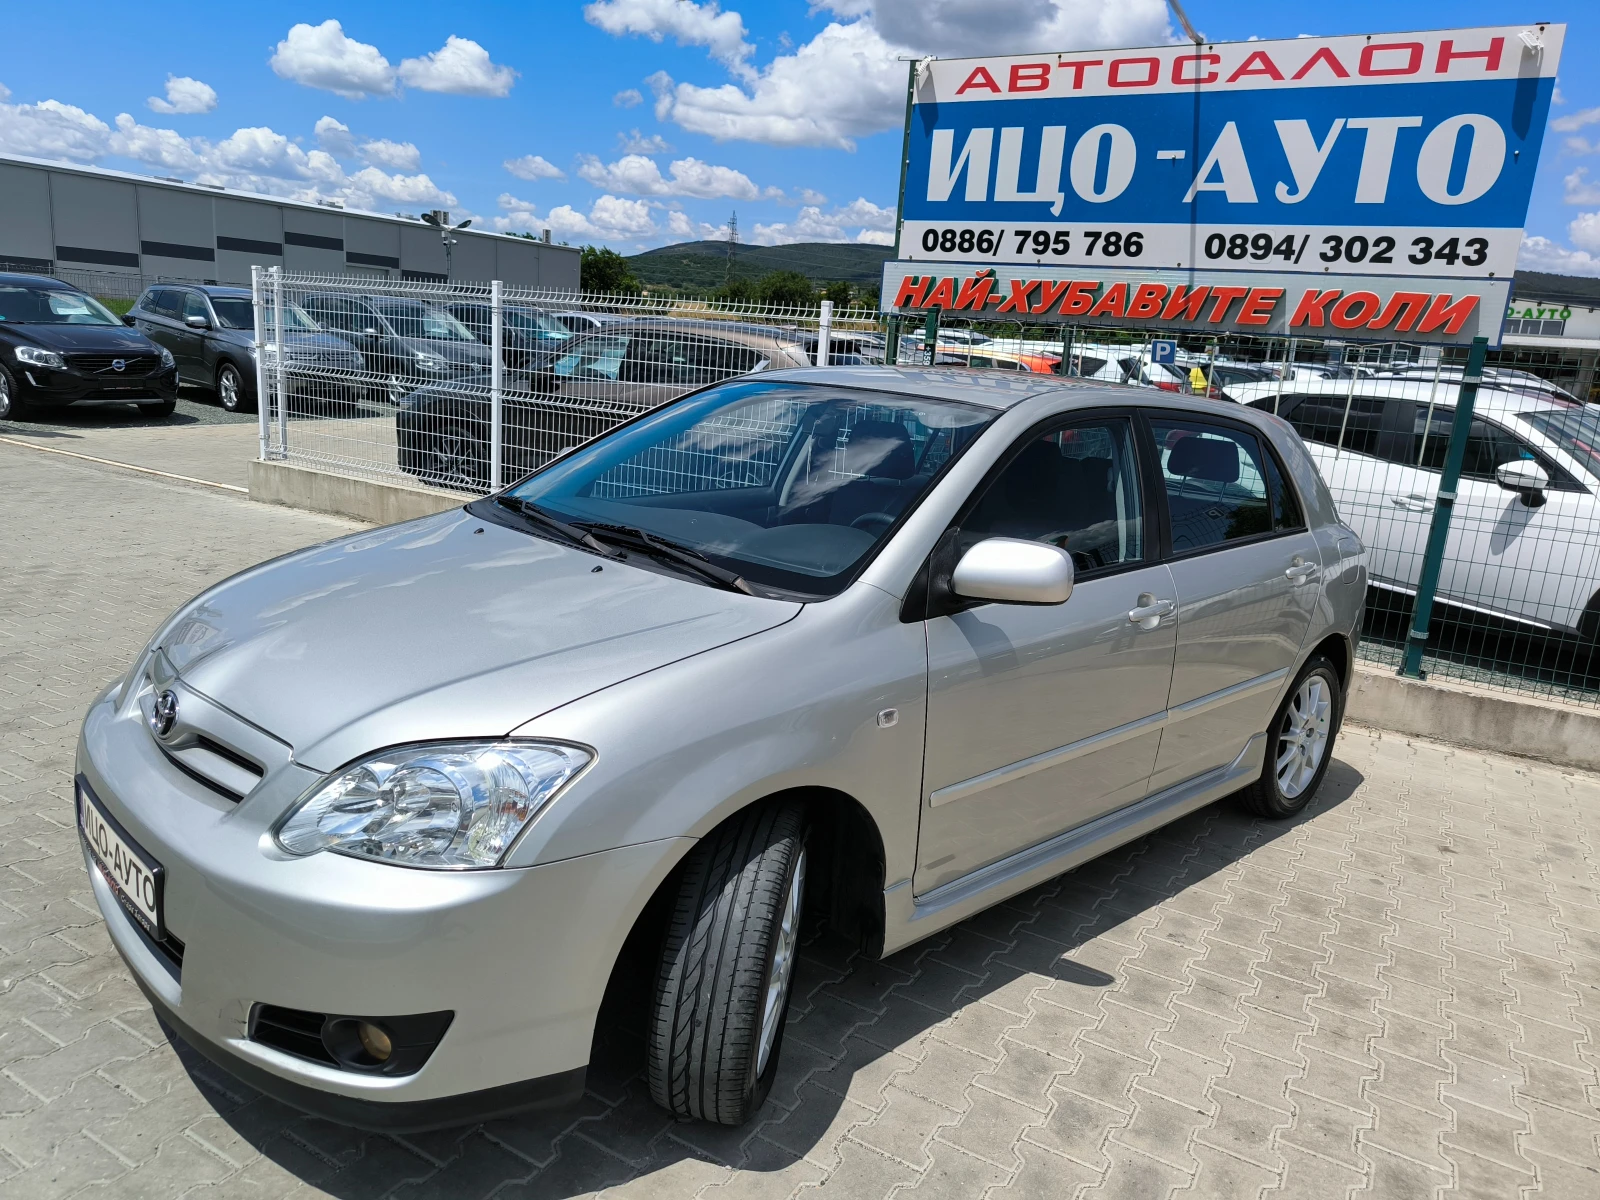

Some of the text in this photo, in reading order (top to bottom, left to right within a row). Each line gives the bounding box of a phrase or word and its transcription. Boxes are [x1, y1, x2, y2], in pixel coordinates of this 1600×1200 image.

[955, 37, 1505, 96] АВТОСАЛОН
[921, 228, 1145, 258] 0886/ 795 786
[1204, 232, 1489, 267] 0894/ 302 343
[894, 269, 1481, 335] НАЙ-ХУБАВИТЕ КОЛИ
[1155, 343, 1170, 361] P
[83, 797, 156, 913] ИЦО-АУТО
